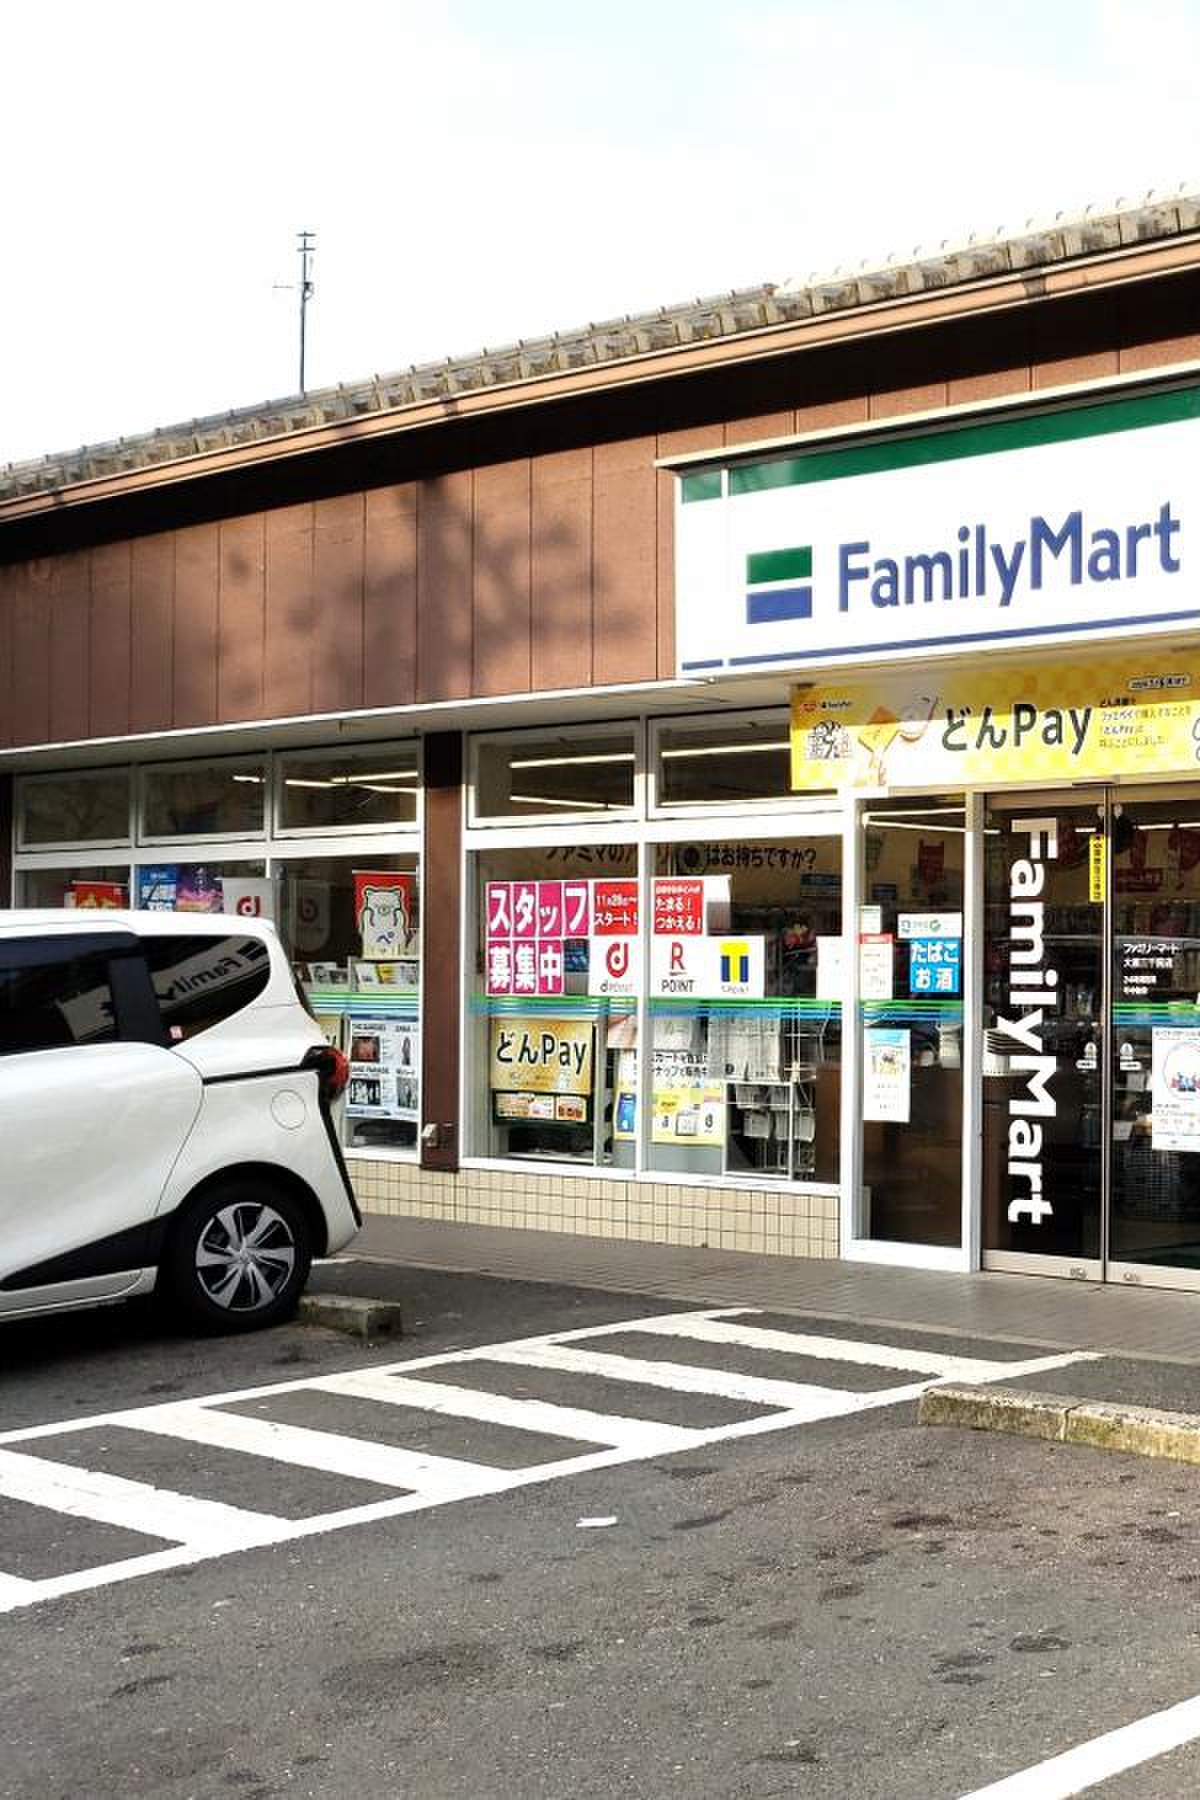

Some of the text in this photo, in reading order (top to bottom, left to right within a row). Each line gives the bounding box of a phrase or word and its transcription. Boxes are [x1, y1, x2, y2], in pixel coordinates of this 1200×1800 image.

[838, 501, 1181, 612] FamilyMart
[941, 703, 1093, 756] どんPay
[489, 887, 588, 932] スタッフ
[594, 911, 638, 927] スタート!
[489, 943, 563, 993] 募集中
[670, 942, 685, 970] R
[911, 941, 959, 963] たばこ
[661, 979, 695, 993] POINT
[915, 967, 953, 991] お酒
[997, 817, 1058, 1226] FamilyMart
[497, 1031, 587, 1075] どんPay
